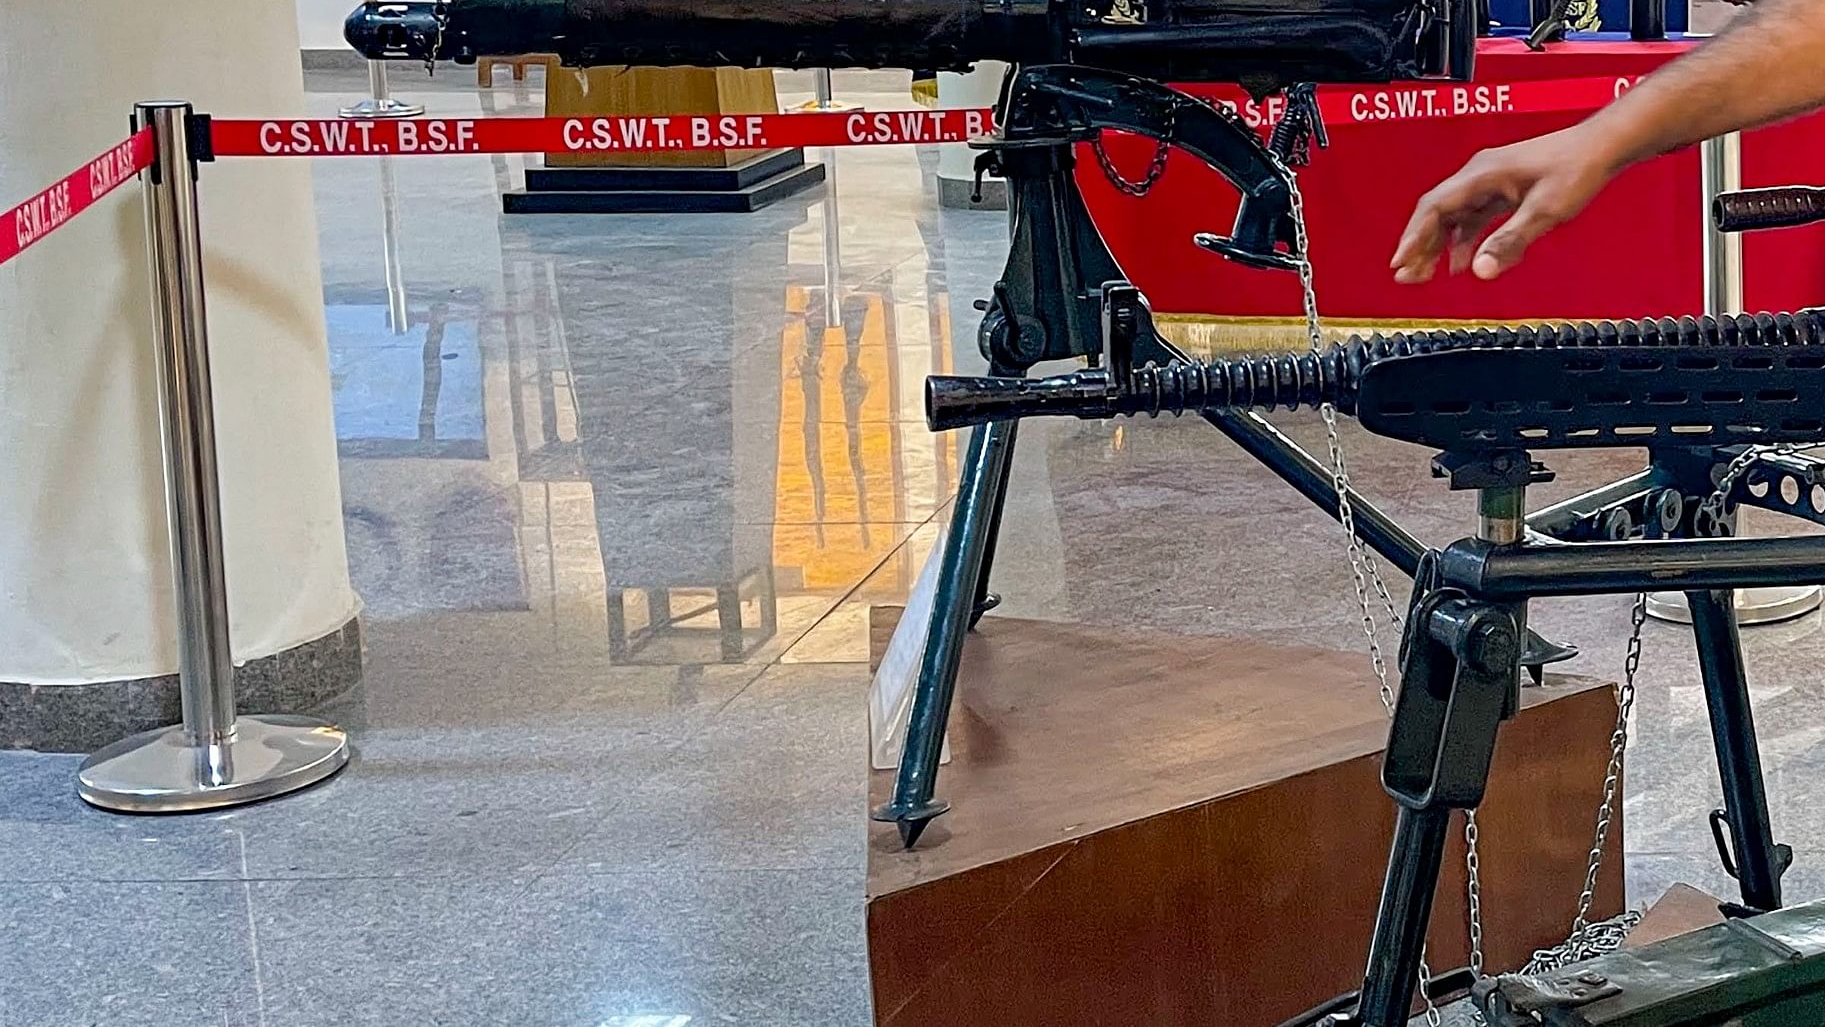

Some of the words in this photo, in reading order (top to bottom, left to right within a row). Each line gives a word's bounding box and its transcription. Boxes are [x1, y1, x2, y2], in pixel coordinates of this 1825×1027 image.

[1454, 86, 1514, 115] B.S.F.
[398, 120, 480, 152] B.S.F.
[691, 116, 767, 148] B.S.F.
